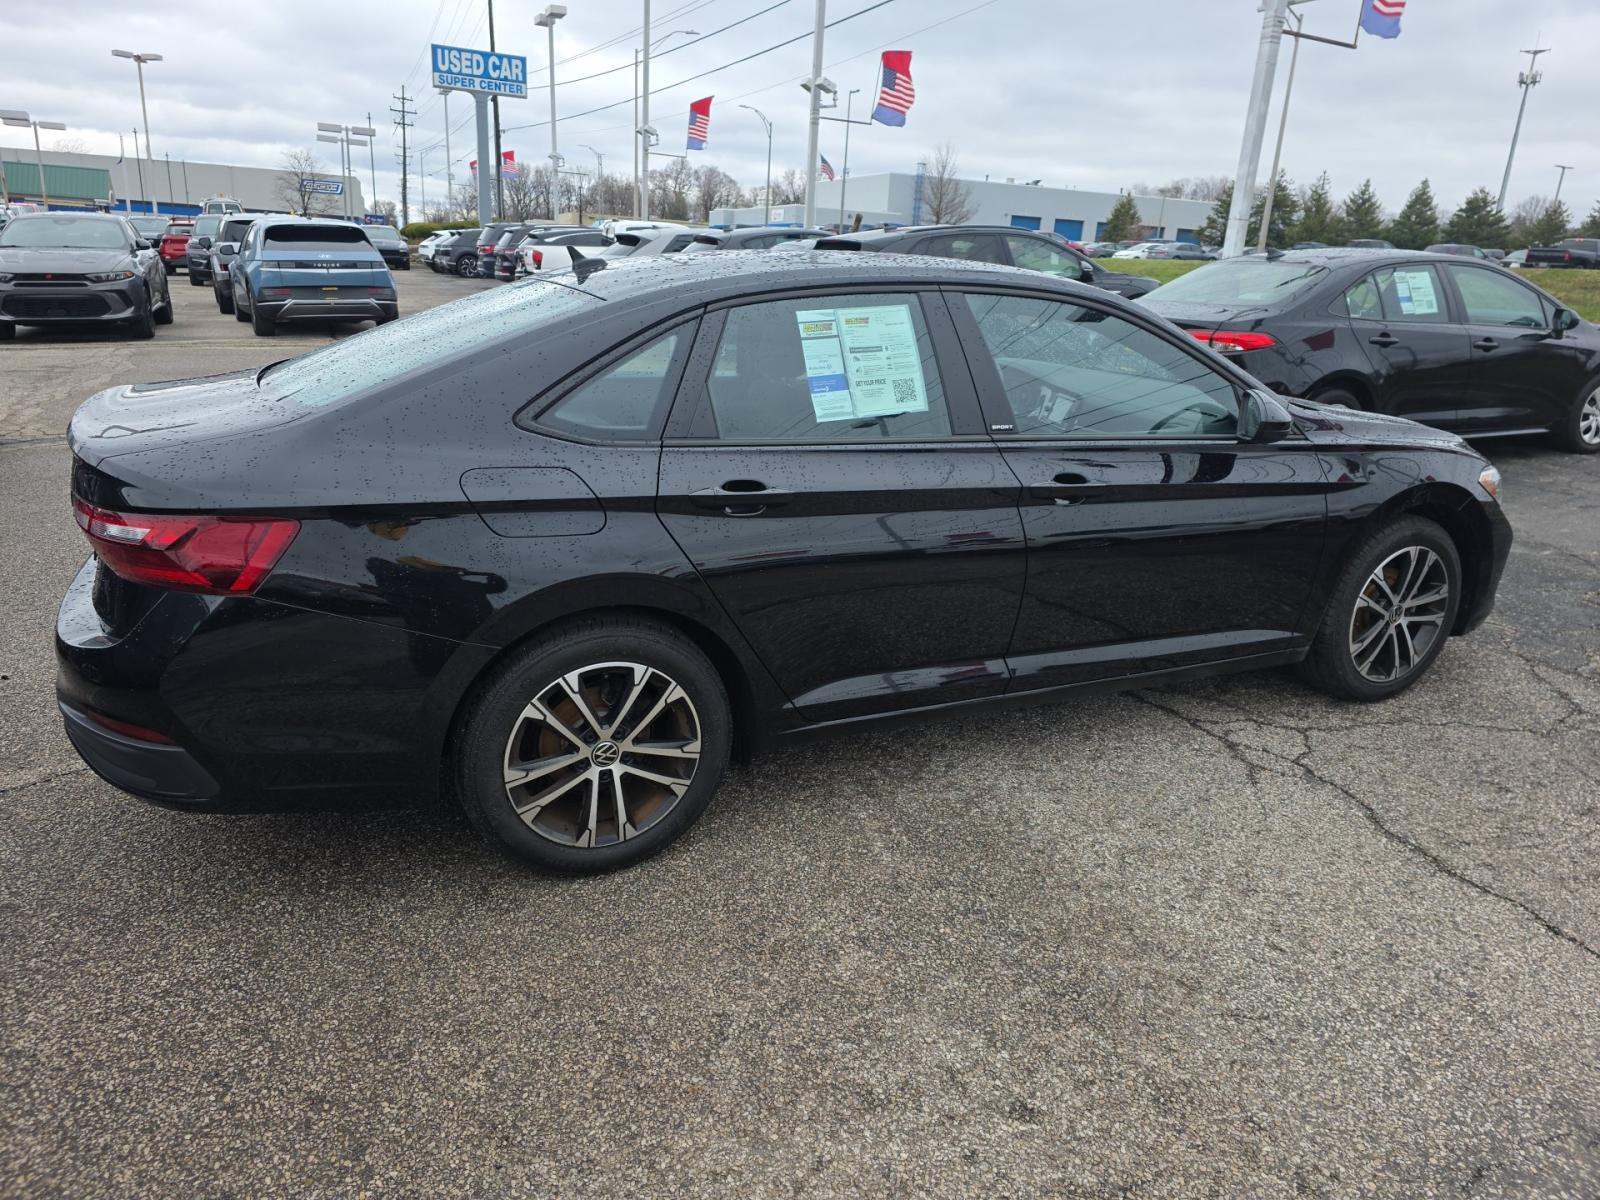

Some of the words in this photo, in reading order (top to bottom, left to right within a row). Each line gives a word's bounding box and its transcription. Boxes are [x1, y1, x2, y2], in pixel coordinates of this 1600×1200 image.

[437, 48, 484, 76] USED
[488, 55, 523, 81] CAR
[438, 75, 476, 89] SUPER
[480, 79, 523, 94] CENTER
